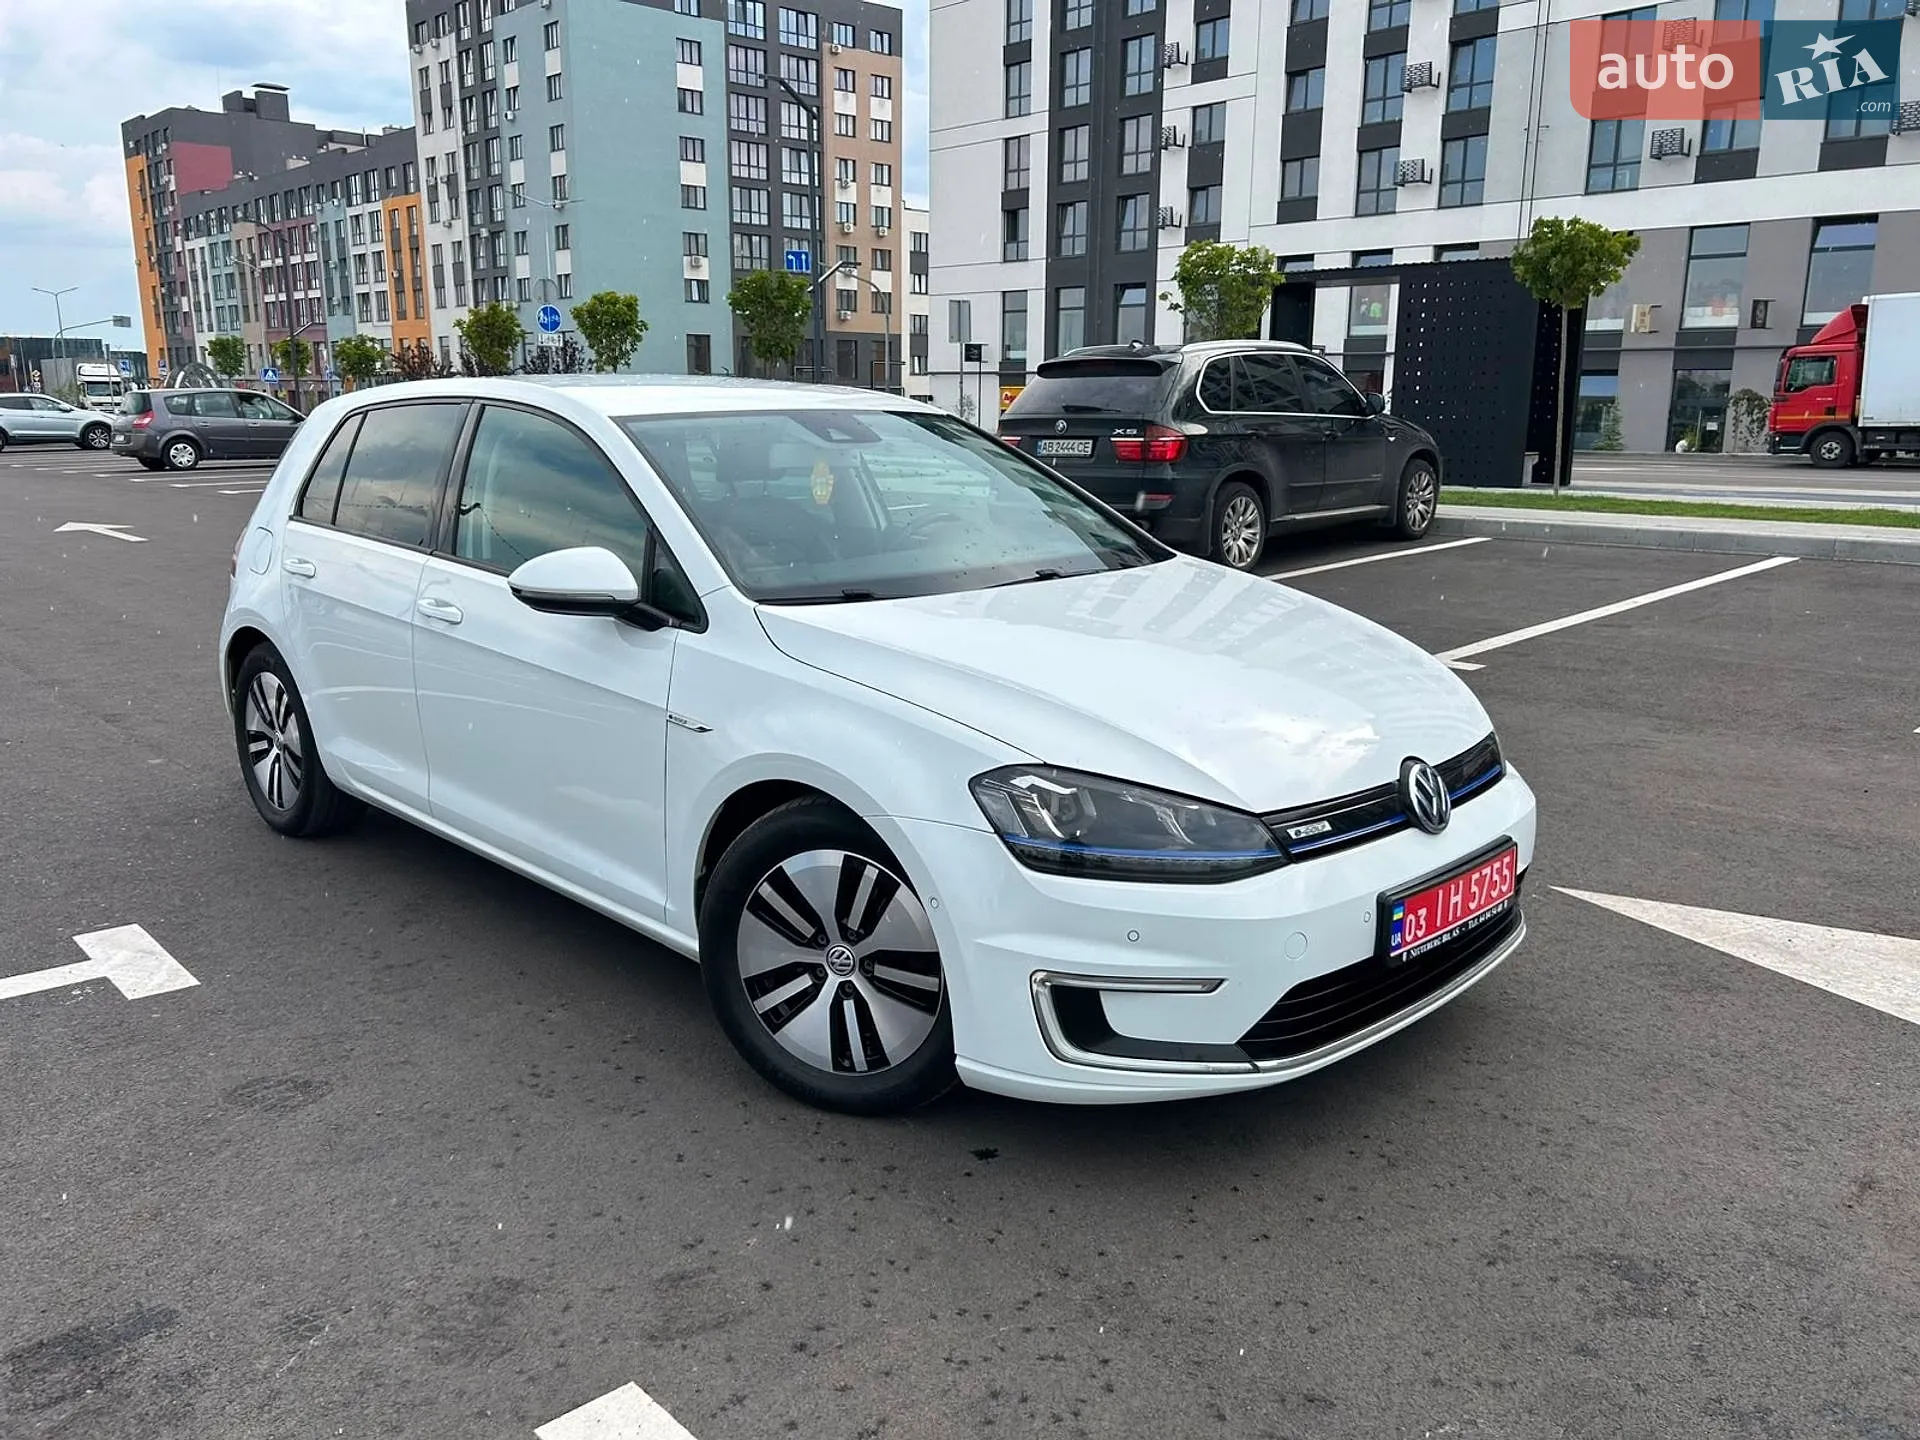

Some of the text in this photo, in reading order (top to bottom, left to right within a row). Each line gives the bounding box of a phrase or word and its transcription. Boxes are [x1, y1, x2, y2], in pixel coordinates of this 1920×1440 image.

[1405, 907, 1427, 943] 03
[1468, 856, 1510, 910] 5755
[1391, 931, 1401, 946] UA
